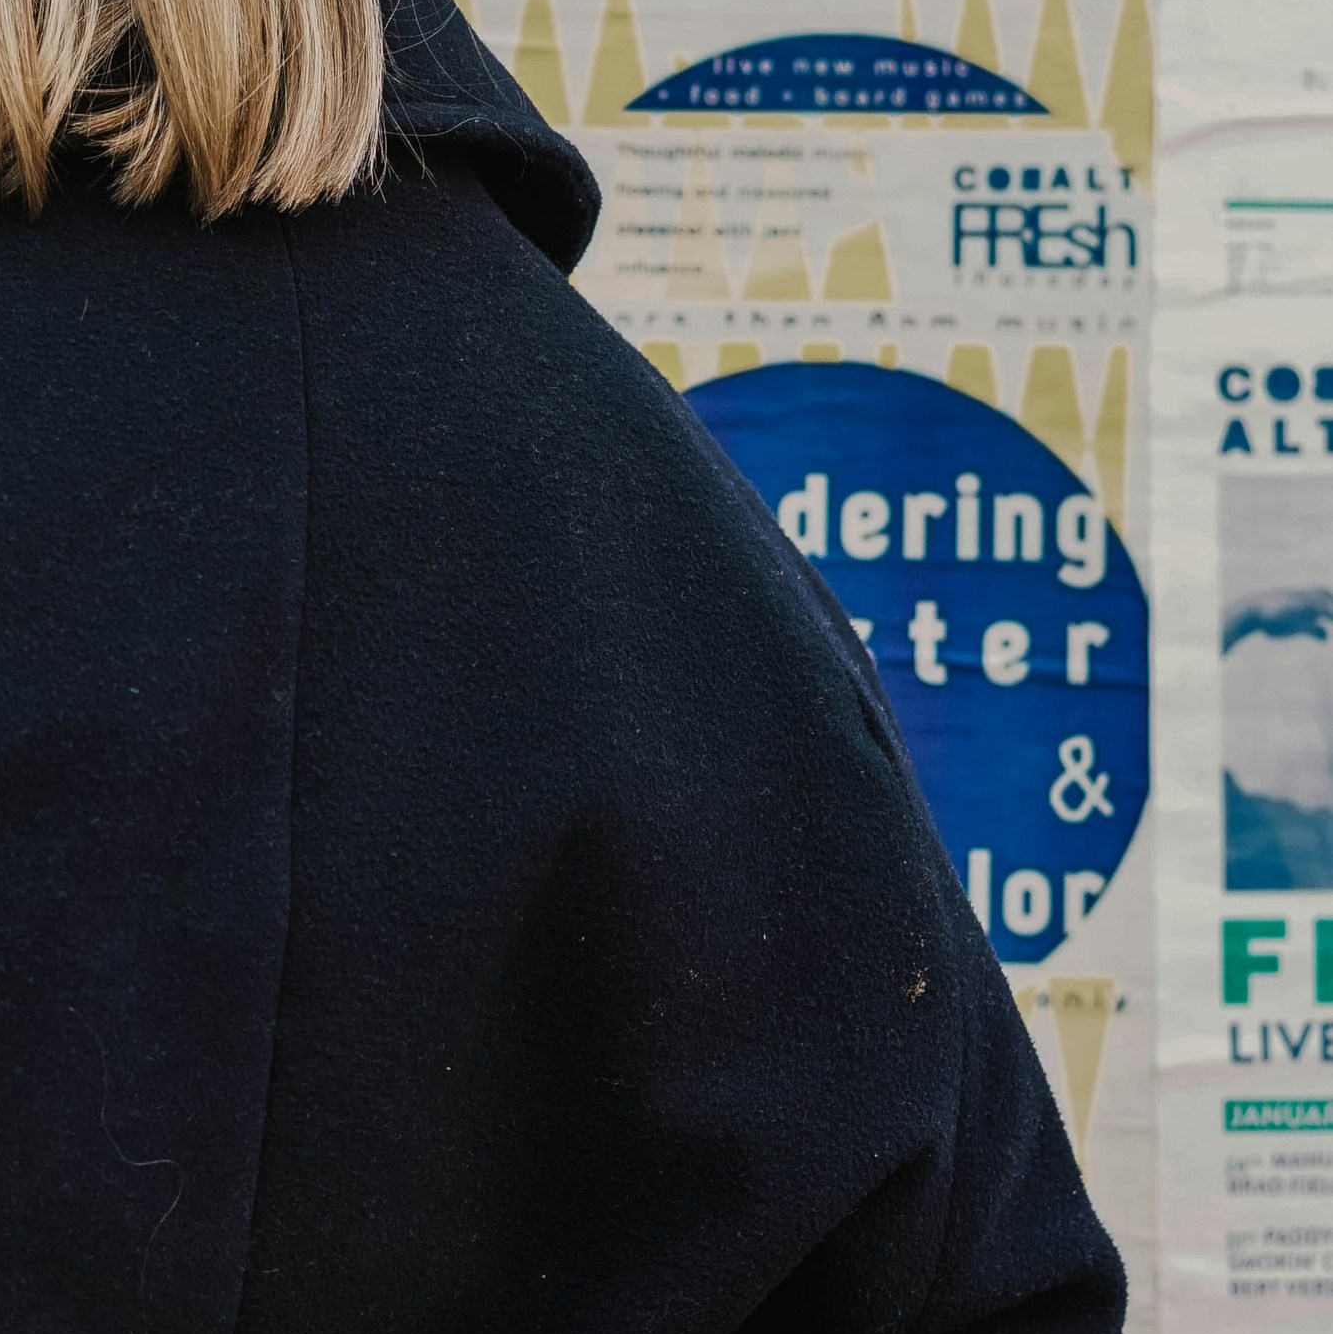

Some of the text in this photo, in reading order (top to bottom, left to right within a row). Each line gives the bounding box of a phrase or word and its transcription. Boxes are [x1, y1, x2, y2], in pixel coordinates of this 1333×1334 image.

[713, 55, 969, 79] live new music
[690, 83, 1028, 112] food board games
[777, 473, 1109, 589] dering
[1049, 734, 1116, 823] &
